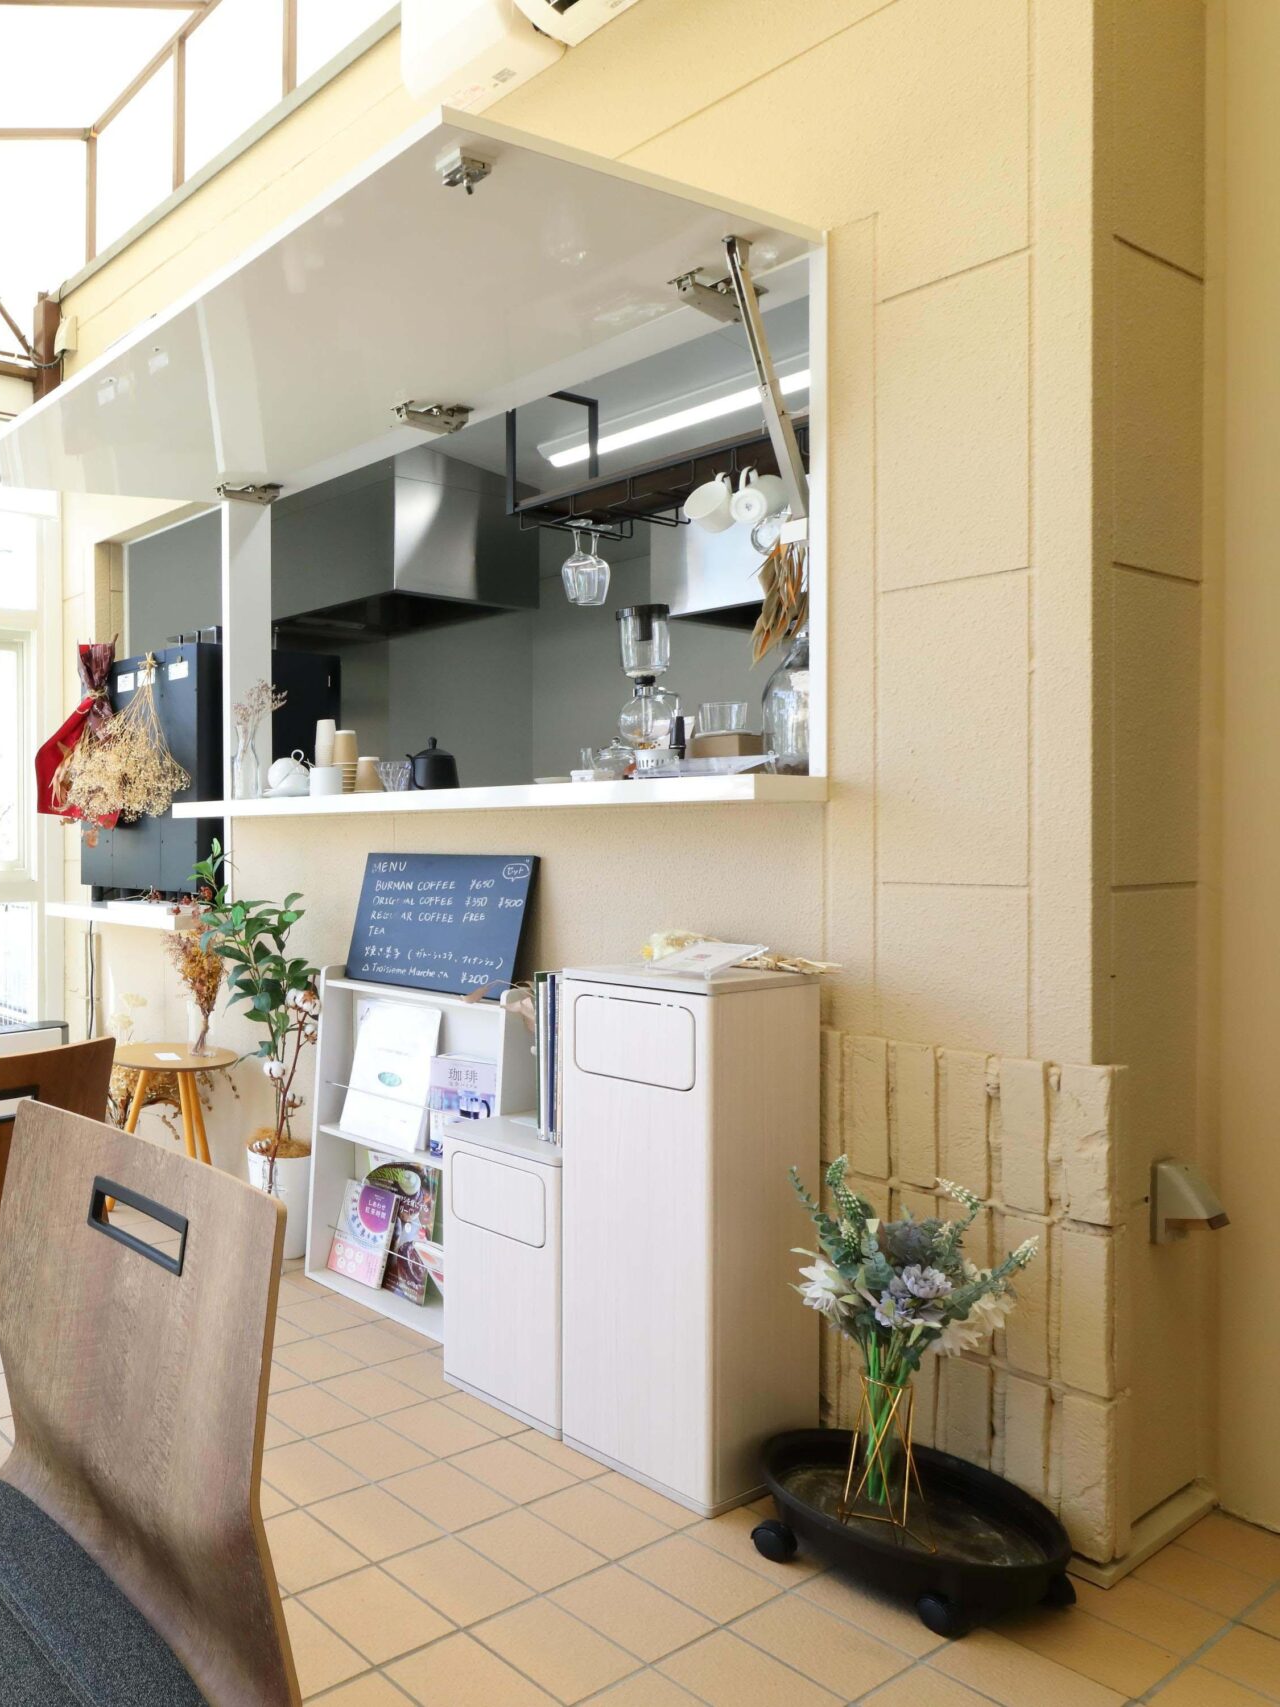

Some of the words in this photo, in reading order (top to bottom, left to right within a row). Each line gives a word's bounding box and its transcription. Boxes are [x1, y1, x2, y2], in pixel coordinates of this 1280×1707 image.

[372, 861, 407, 873] MENU
[375, 880, 414, 892] BURMAN
[417, 880, 456, 891] COFFEE
[372, 895, 415, 906] ORIGAL
[419, 896, 454, 906] COFFEE
[498, 897, 524, 909] ¥500
[370, 910, 413, 920] REGAR
[418, 911, 454, 923] COFFEE
[462, 912, 486, 923] FREE
[368, 925, 385, 937] TEA
[461, 971, 489, 985] ¥200
